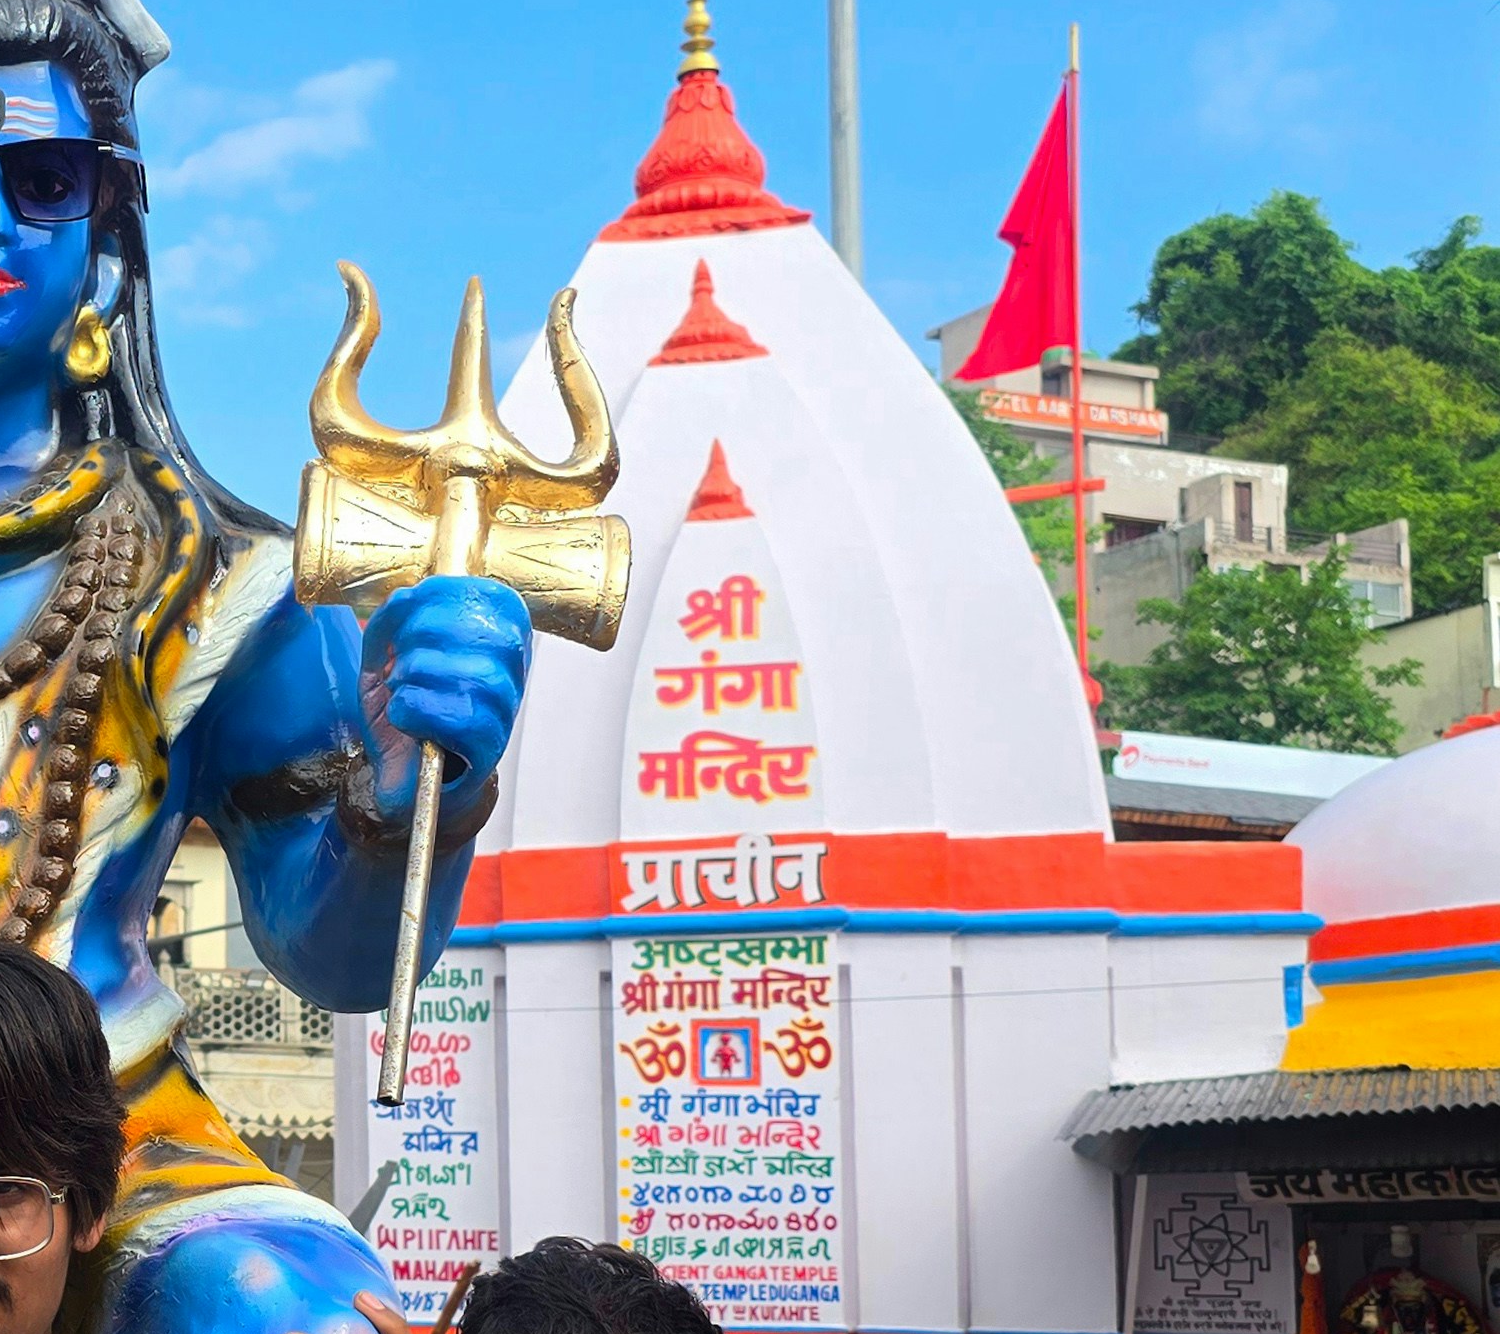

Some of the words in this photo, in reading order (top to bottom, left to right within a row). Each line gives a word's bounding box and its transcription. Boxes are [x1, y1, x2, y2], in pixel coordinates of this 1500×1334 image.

[677, 575, 764, 640] श्री
[654, 649, 801, 714] गंगा
[638, 730, 816, 804] मन्दिर
[620, 833, 827, 912] प्राचीन
[621, 972, 658, 1015] श्री
[662, 971, 720, 1012] गंगा
[731, 968, 831, 1012] मन्दिर
